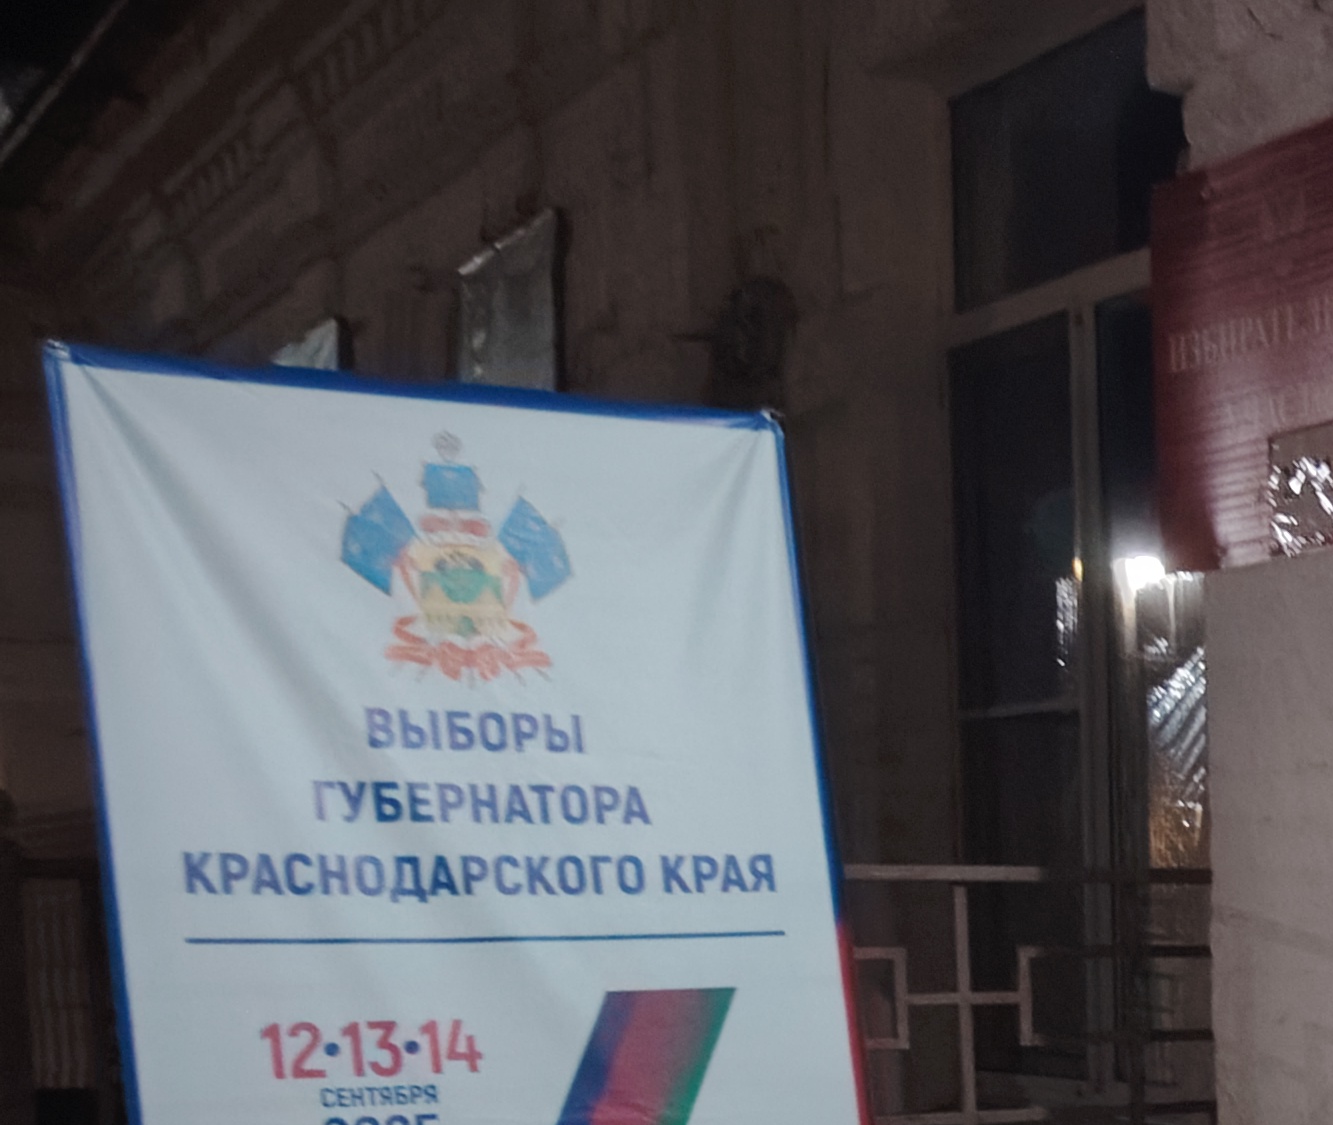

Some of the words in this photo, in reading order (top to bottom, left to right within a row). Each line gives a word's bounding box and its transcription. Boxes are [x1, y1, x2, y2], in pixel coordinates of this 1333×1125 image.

[365, 706, 586, 755] ВЫБОРЫ
[312, 779, 651, 825] ГУБЕРНАТОРА
[182, 851, 647, 903] КРАСНОДАРСКОГО
[661, 852, 777, 895] КРАЯ
[319, 1083, 440, 1108] СЕНТЯБРЯ
